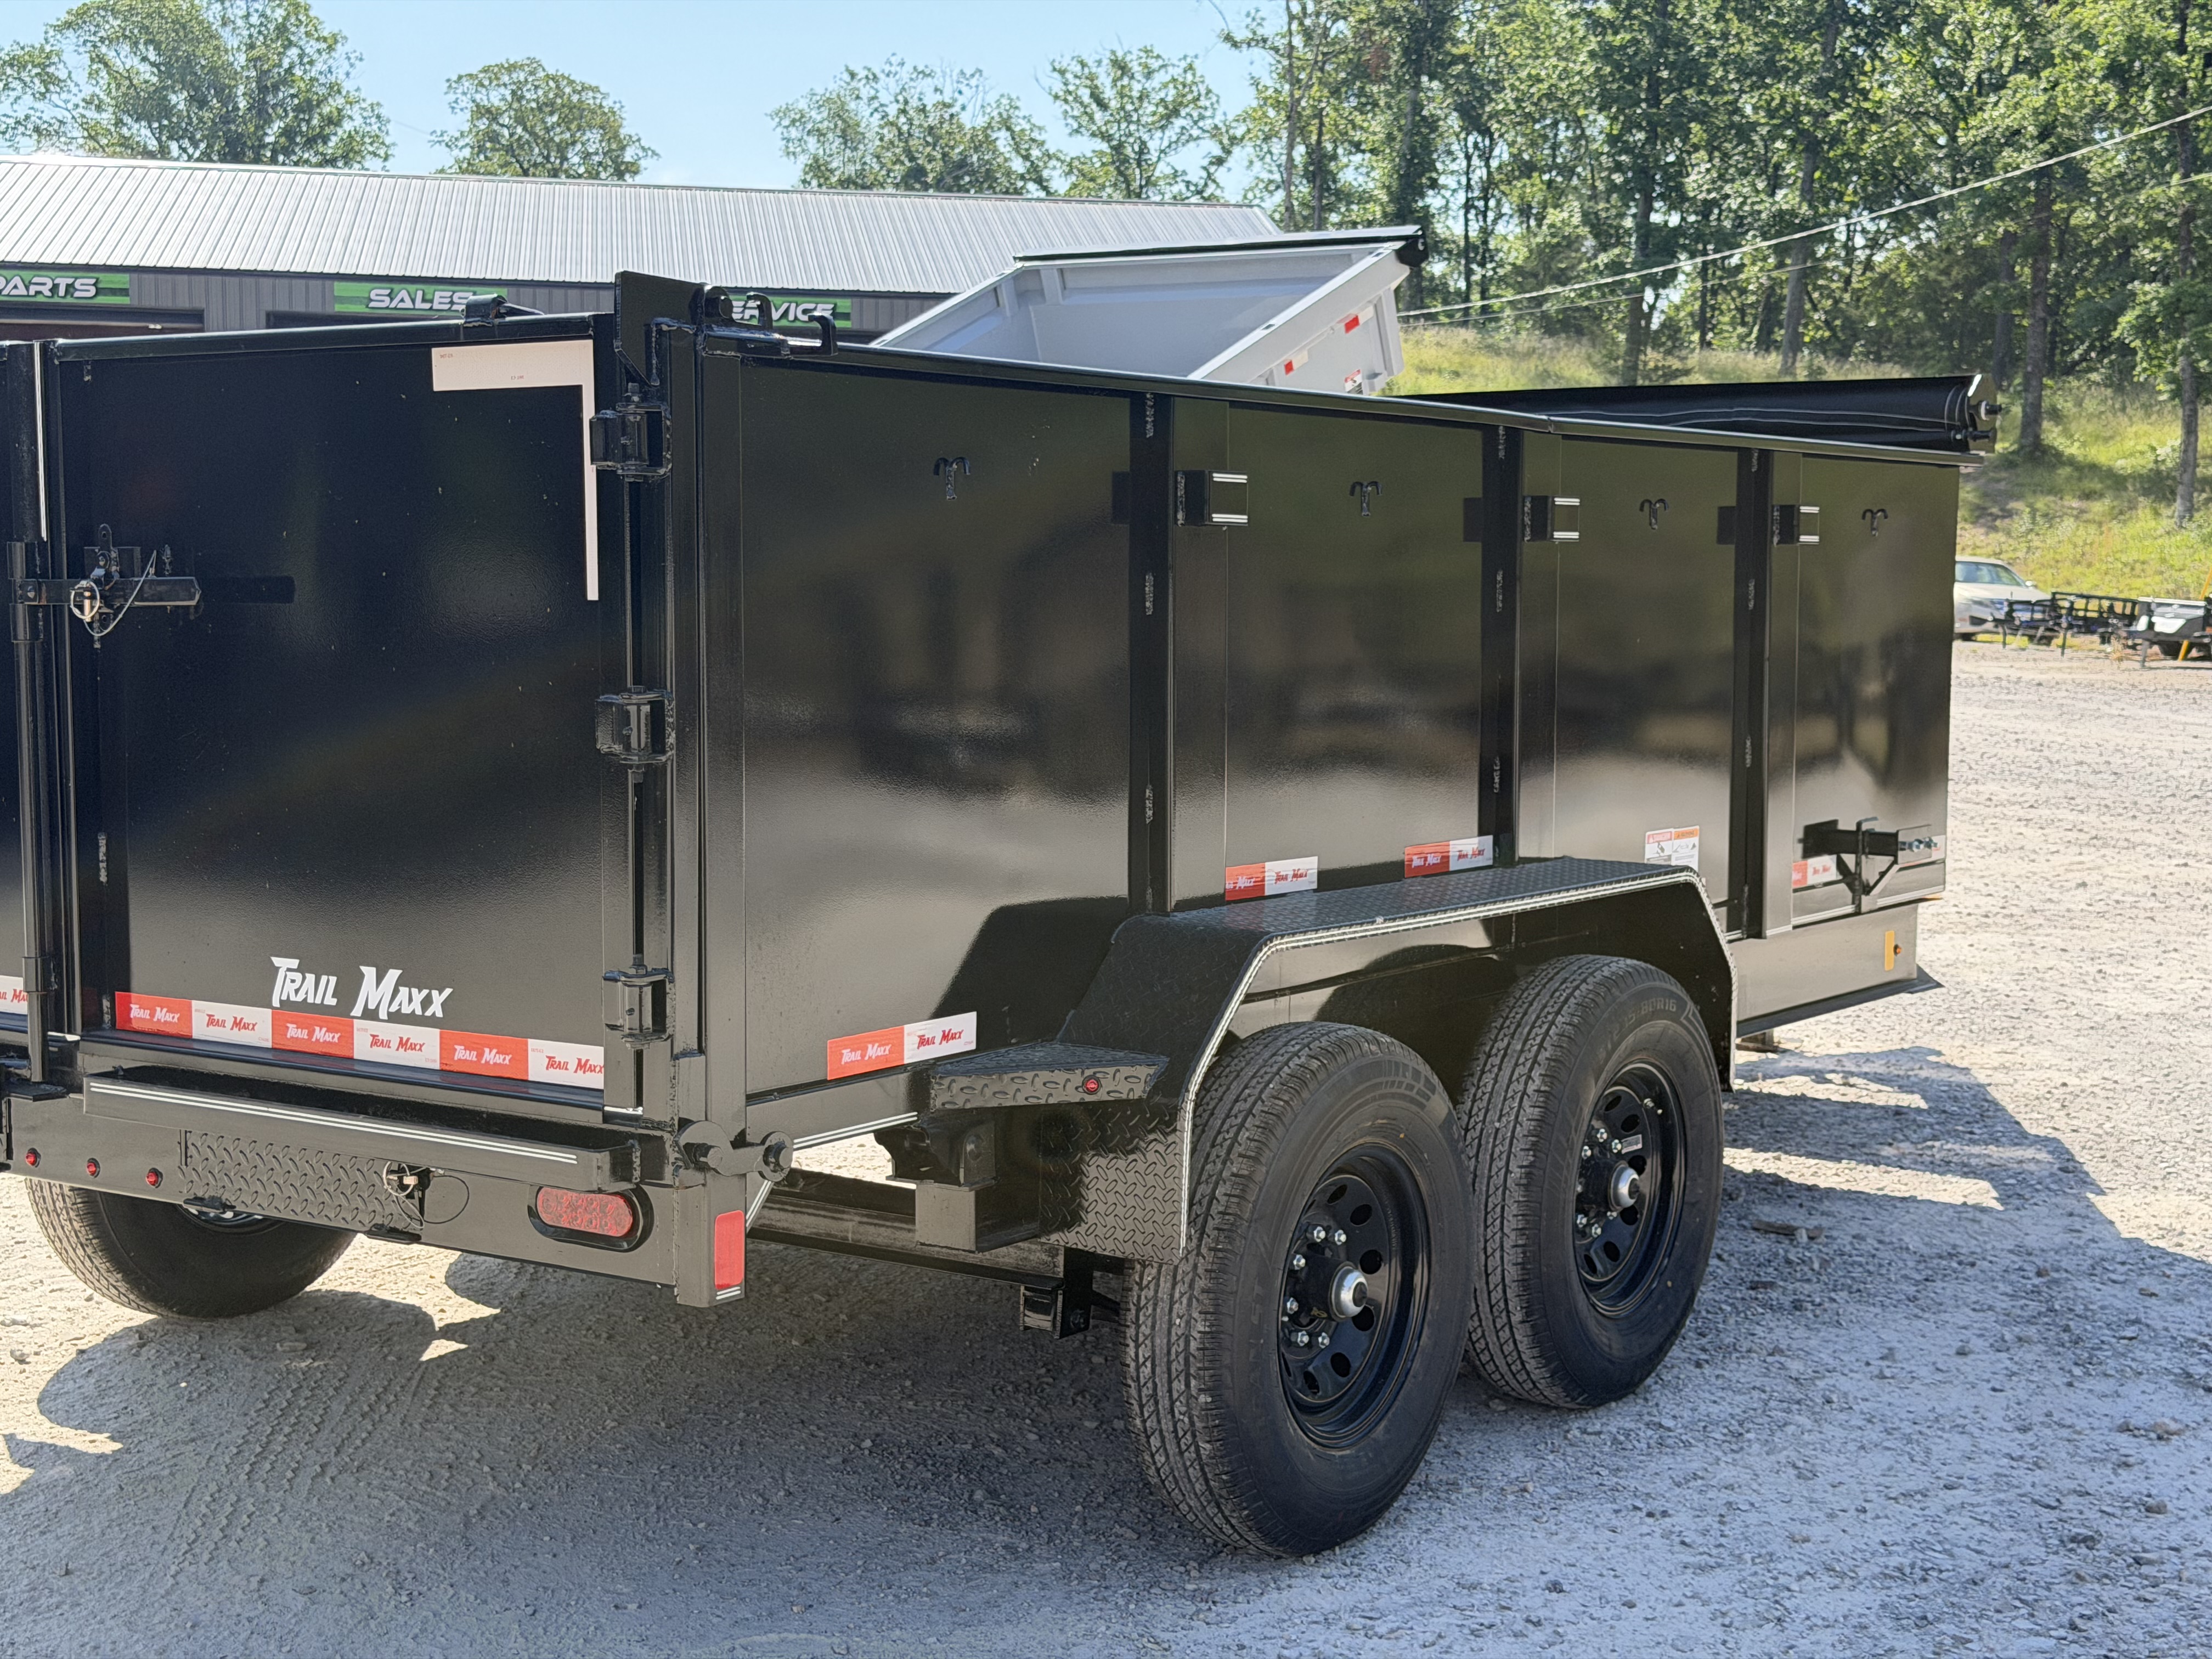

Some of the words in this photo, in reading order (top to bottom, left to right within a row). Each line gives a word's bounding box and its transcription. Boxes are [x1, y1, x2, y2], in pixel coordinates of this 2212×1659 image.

[0, 275, 97, 297] ARTS
[368, 289, 473, 311] SALES
[732, 300, 834, 321] ERVICE
[10, 988, 28, 1003] MA
[270, 956, 337, 1007] TRAIL
[350, 965, 453, 1020] MAXX
